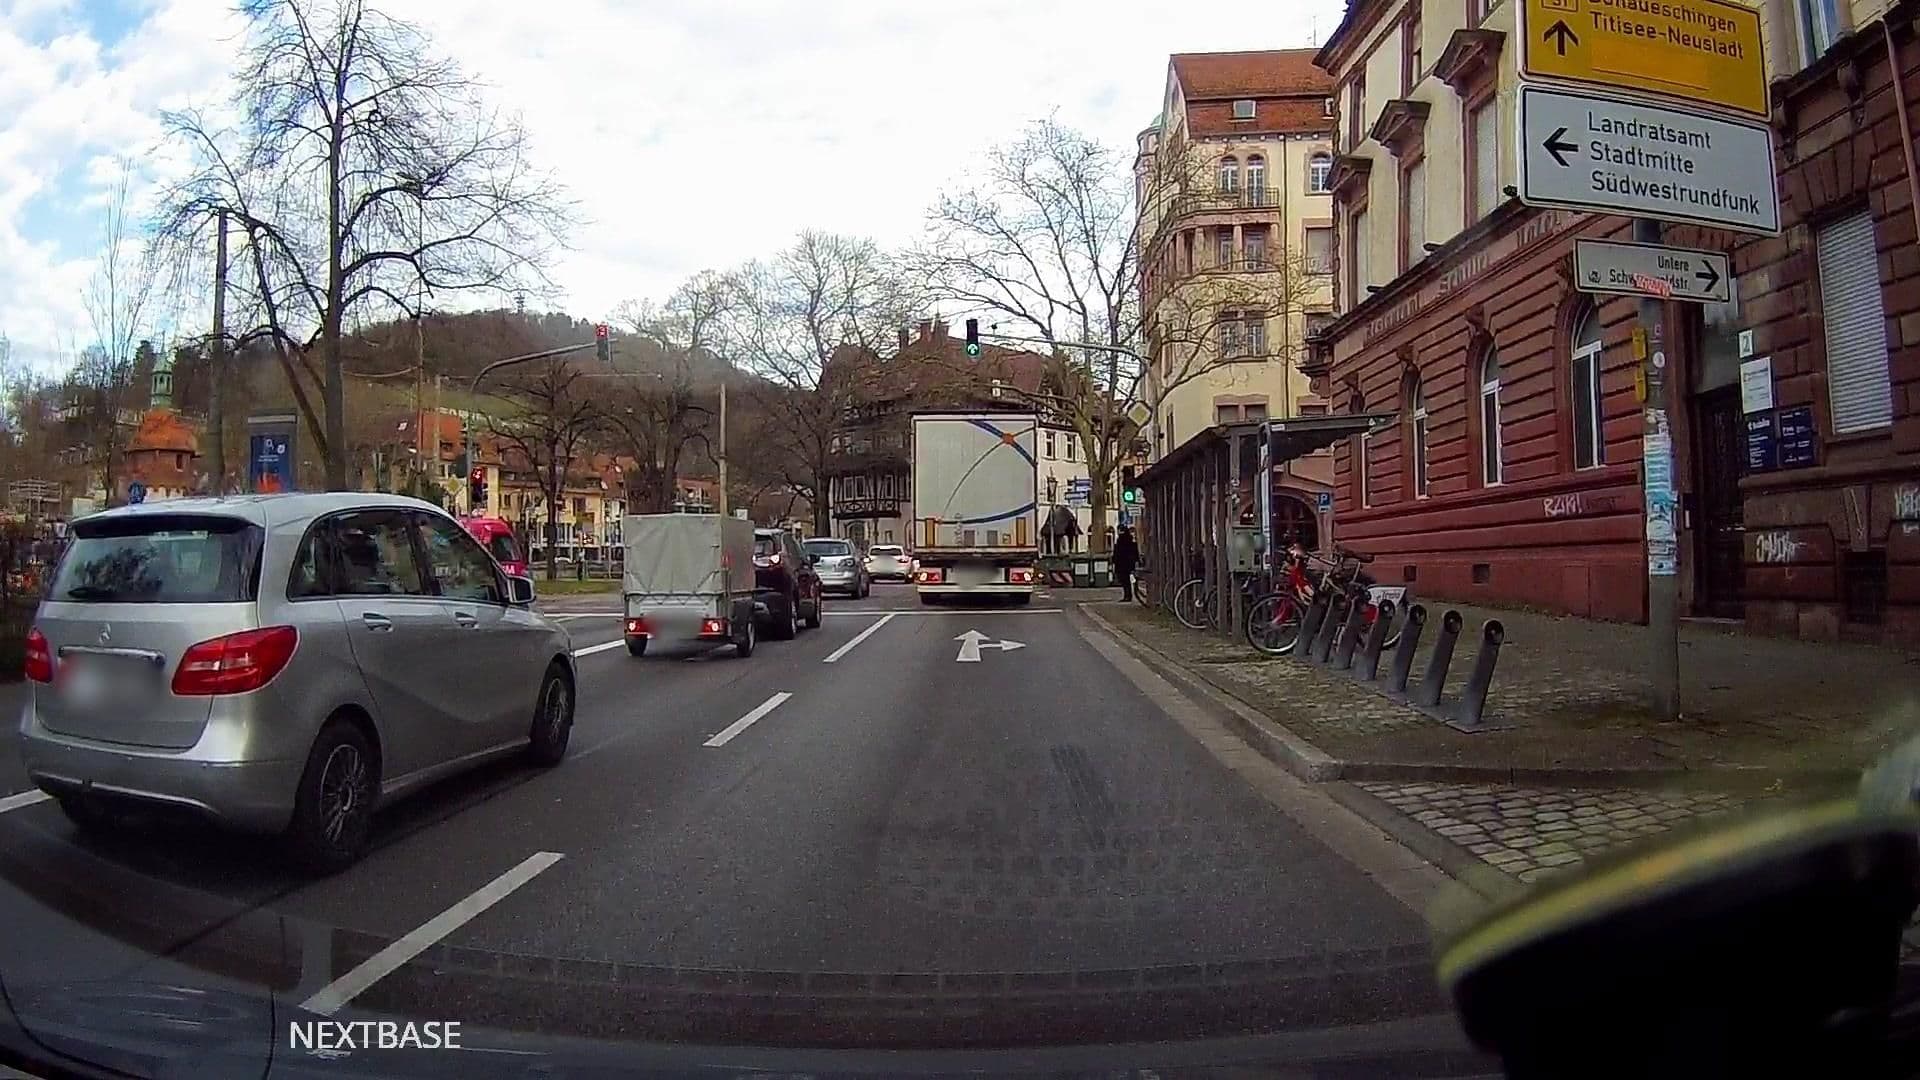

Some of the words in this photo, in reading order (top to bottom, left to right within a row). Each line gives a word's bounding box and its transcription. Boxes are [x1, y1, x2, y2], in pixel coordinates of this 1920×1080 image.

[1588, 0, 1737, 33] naueschingen
[1589, 11, 1744, 60] Titisee-Neustadt
[1588, 111, 1712, 150] Landratsamt
[1590, 141, 1695, 175] Stadtmitte
[1591, 170, 1760, 215] Südwestrundfunk
[1657, 255, 1690, 272] Untere
